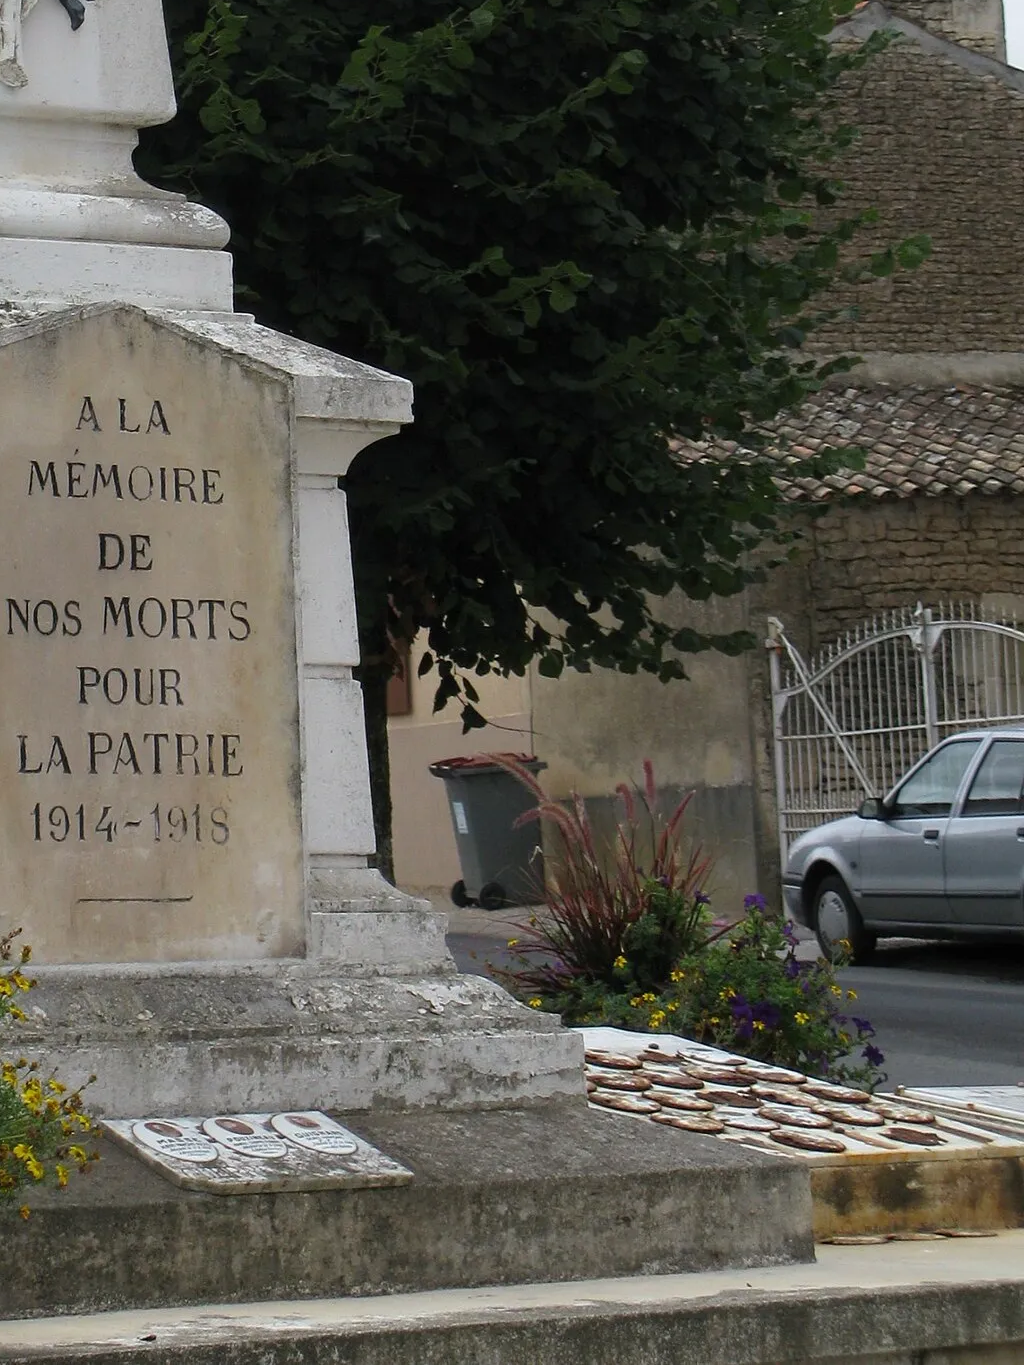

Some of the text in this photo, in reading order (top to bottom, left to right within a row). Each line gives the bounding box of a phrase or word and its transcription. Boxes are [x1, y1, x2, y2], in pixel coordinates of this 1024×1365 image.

[76, 396, 171, 435] A LA
[28, 448, 224, 504] MÉMOIRE
[98, 533, 153, 571] DE
[6, 596, 251, 642] NOS MORTS
[76, 666, 184, 706] POUR
[16, 731, 244, 777] LA PATRIE
